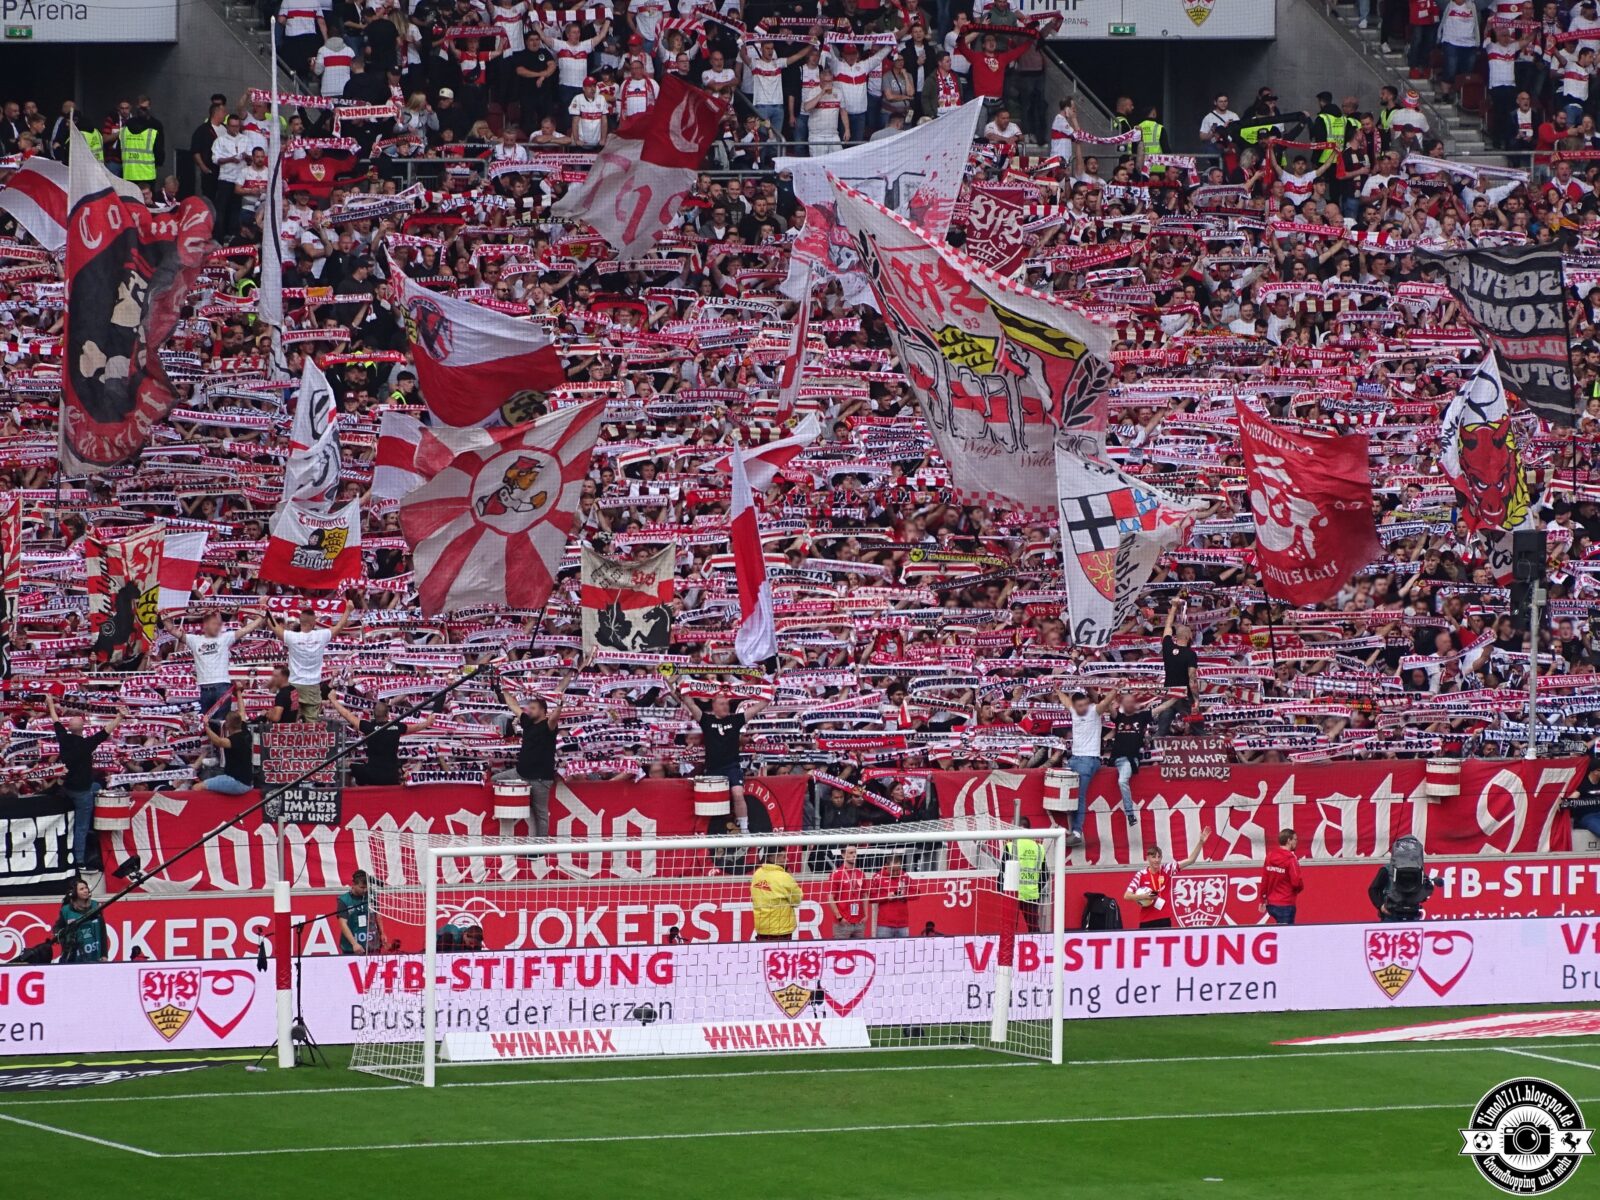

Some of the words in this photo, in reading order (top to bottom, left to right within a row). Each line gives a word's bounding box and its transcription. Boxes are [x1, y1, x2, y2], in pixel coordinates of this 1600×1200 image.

[828, 33, 844, 43] VfB
[847, 34, 893, 44] Stuttgart
[964, 317, 980, 332] 93
[269, 600, 291, 609] CC
[317, 599, 342, 609] 97
[270, 722, 327, 734] JEDER
[262, 733, 336, 748] VERBANNTE
[270, 748, 328, 759] KEHRT
[1187, 753, 1229, 766] KAMPF
[411, 770, 484, 783] COMMANDO
[1160, 766, 1187, 778] UMS
[1189, 766, 1231, 779] GANZE
[284, 790, 305, 802] DU
[309, 790, 337, 802] BIST
[283, 800, 337, 812] IMMER
[284, 811, 304, 823] BEI
[308, 811, 337, 823] UNS!
[104, 791, 658, 894] Commando
[1476, 767, 1578, 854] 97
[943, 881, 972, 907] 35
[965, 932, 1278, 973] VB-STIFTUNG
[348, 950, 675, 995] VfB-STIFTUNG
[1115, 978, 1161, 1006] der
[1177, 977, 1277, 1004] Herzen
[350, 1001, 490, 1033] Brustring
[504, 999, 550, 1027] der
[491, 1029, 618, 1058] WINAMAX
[703, 1022, 827, 1050] WINAMAX
